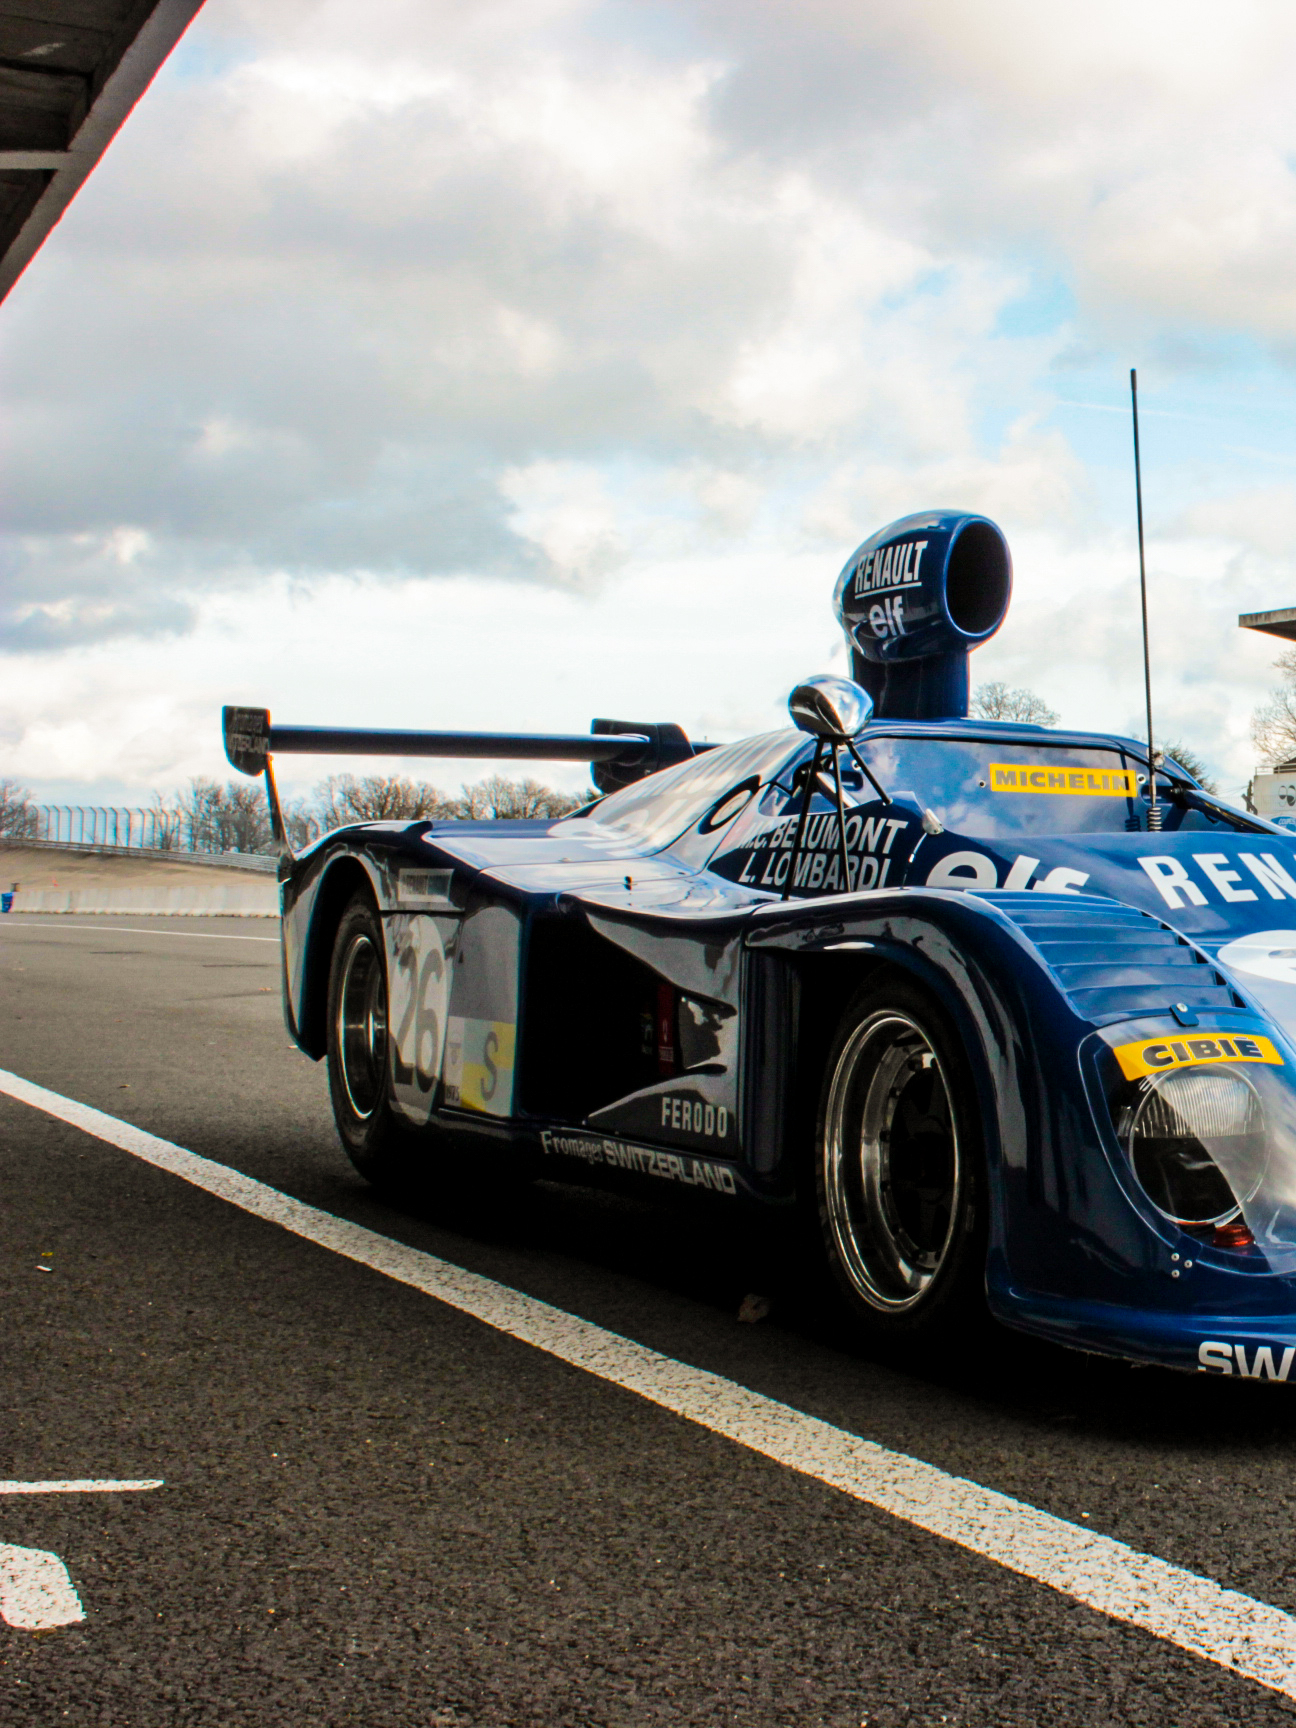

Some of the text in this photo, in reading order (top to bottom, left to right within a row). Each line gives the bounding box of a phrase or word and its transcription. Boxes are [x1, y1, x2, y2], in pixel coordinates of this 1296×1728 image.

[855, 541, 928, 594] RENAULT
[869, 595, 906, 638] elf
[995, 770, 1130, 791] MICHELIN
[738, 852, 892, 890] L. LOMBARDI
[394, 946, 444, 1094] 26
[480, 1031, 499, 1101] S
[661, 1097, 728, 1138] FERODO
[540, 1130, 736, 1194] Fromages SWITZERLAND
